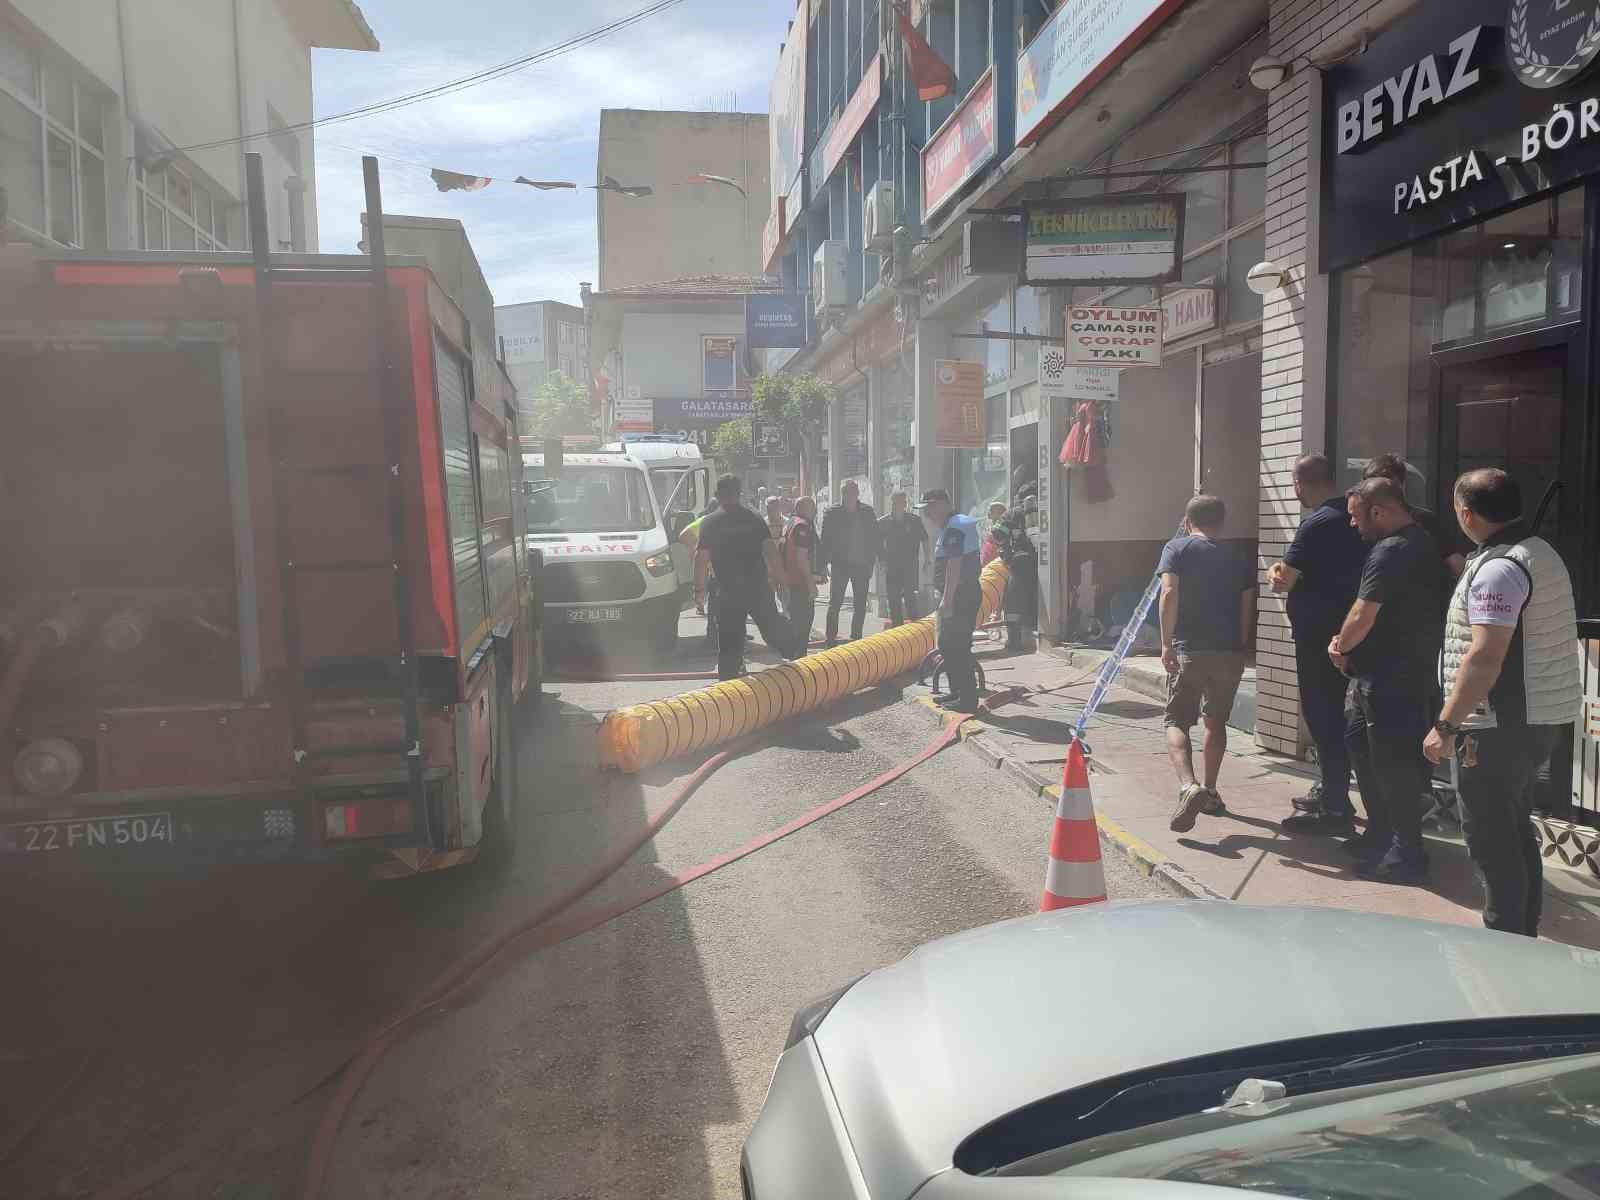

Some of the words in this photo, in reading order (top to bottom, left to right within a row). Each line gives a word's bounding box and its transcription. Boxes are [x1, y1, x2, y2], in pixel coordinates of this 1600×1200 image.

[1337, 24, 1482, 154] BEYAZ
[1394, 150, 1483, 214] PASTA
[1522, 98, 1600, 162] BÖR
[1071, 308, 1157, 322] OYLUM
[1071, 323, 1157, 334] ÇAMAŞIR
[1079, 336, 1156, 347] ÇORAP
[1091, 349, 1141, 359] TAKI
[681, 400, 757, 410] GALATASARA
[545, 544, 633, 554] TFAİYE
[24, 824, 59, 852] 22
[67, 821, 106, 848] FN
[115, 816, 167, 844] 504
